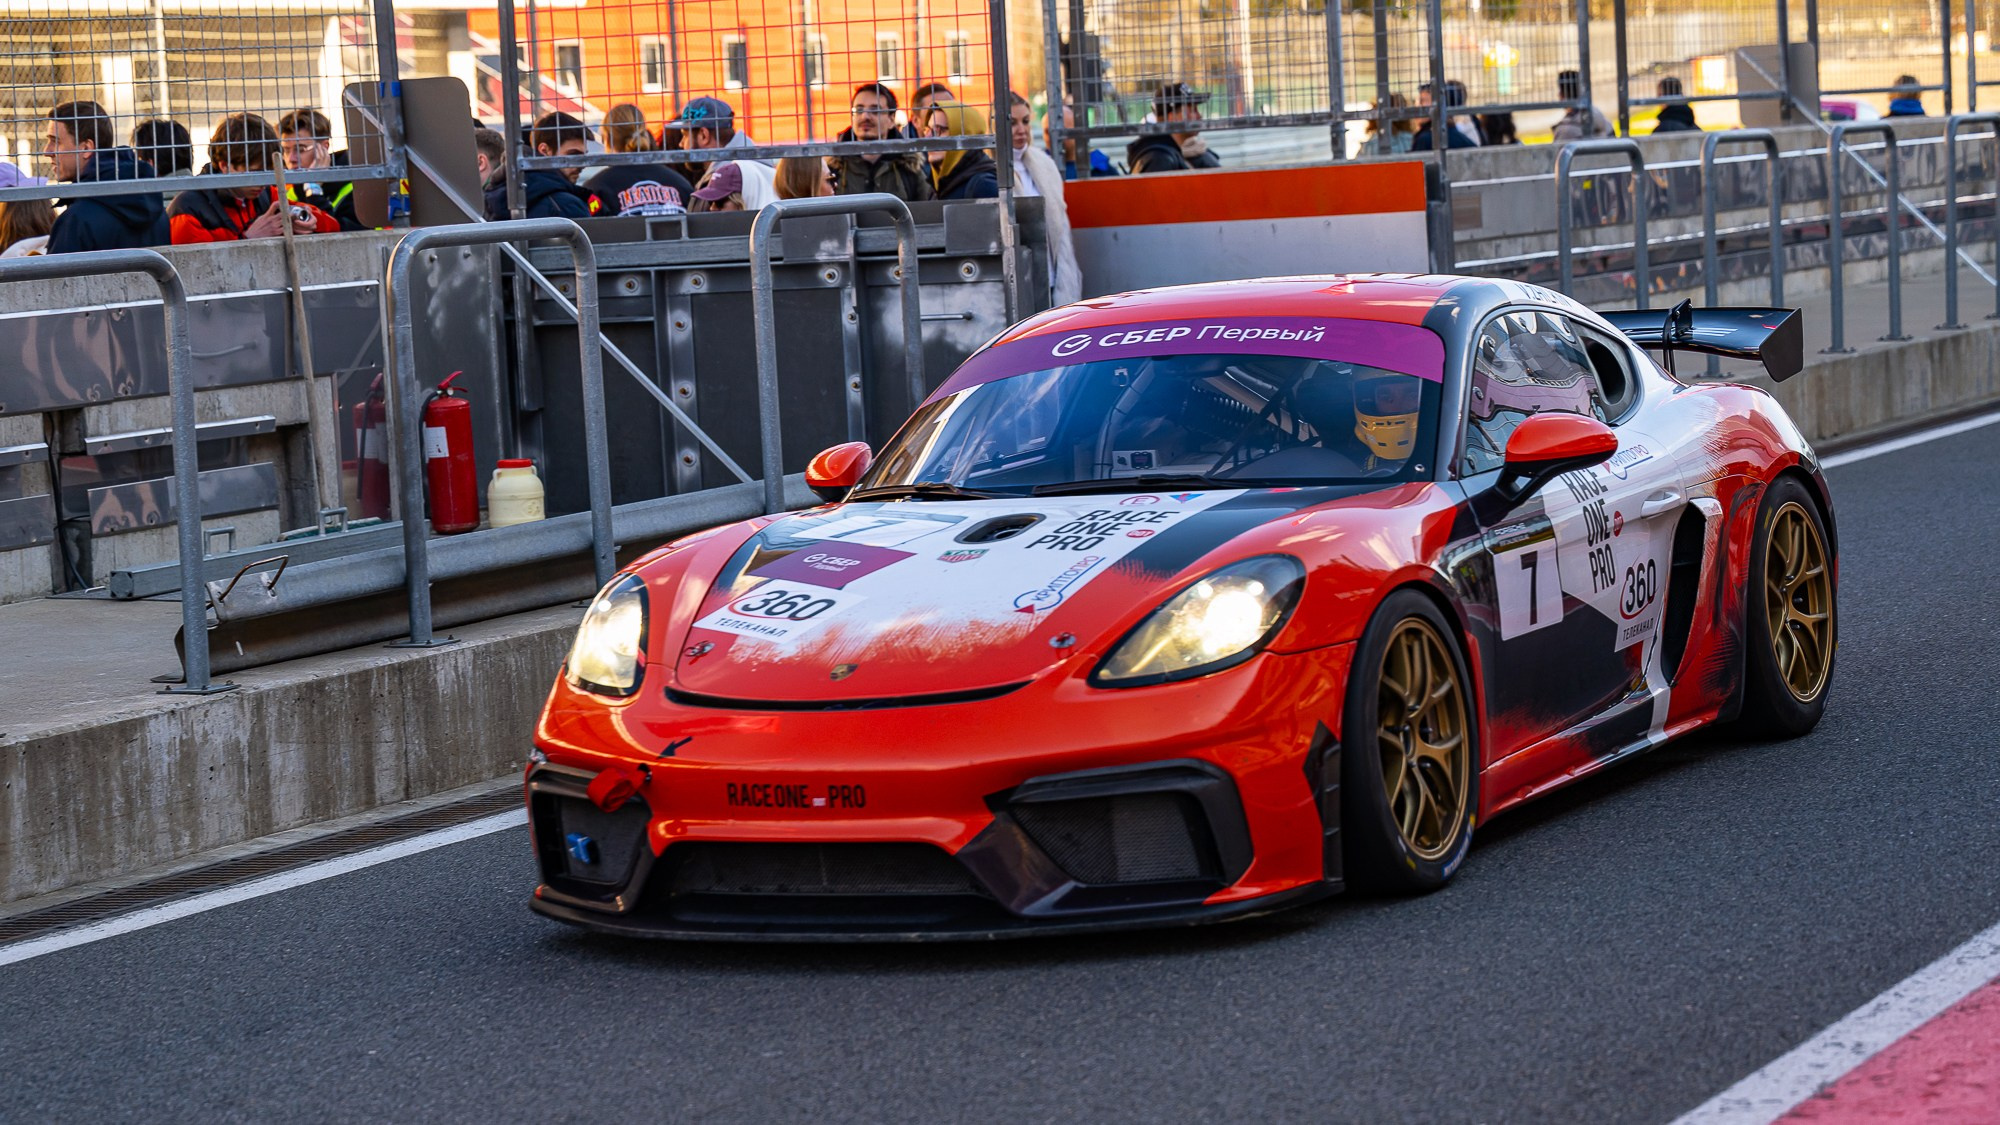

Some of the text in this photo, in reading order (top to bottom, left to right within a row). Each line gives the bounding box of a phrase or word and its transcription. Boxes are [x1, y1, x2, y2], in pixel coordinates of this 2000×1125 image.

[618, 185, 683, 211] LEADER
[1098, 325, 1326, 347] СБЕР Первый
[1053, 522, 1134, 535] ONE
[1075, 510, 1180, 523] RACE
[1583, 498, 1610, 547] ONE
[828, 519, 907, 539] 7
[1024, 535, 1106, 551] PRO
[821, 556, 862, 567] СБЕР
[1588, 543, 1616, 593] PRO
[1032, 556, 1100, 602] КРИПТОПРО
[1520, 550, 1538, 626] 7
[1625, 558, 1656, 613] 360
[741, 590, 836, 621] 360
[714, 617, 788, 638] ТЕЛЕКАНАЛ
[1622, 617, 1654, 642] ТЕЛЕКАНАЛ
[828, 784, 866, 808] PRO
